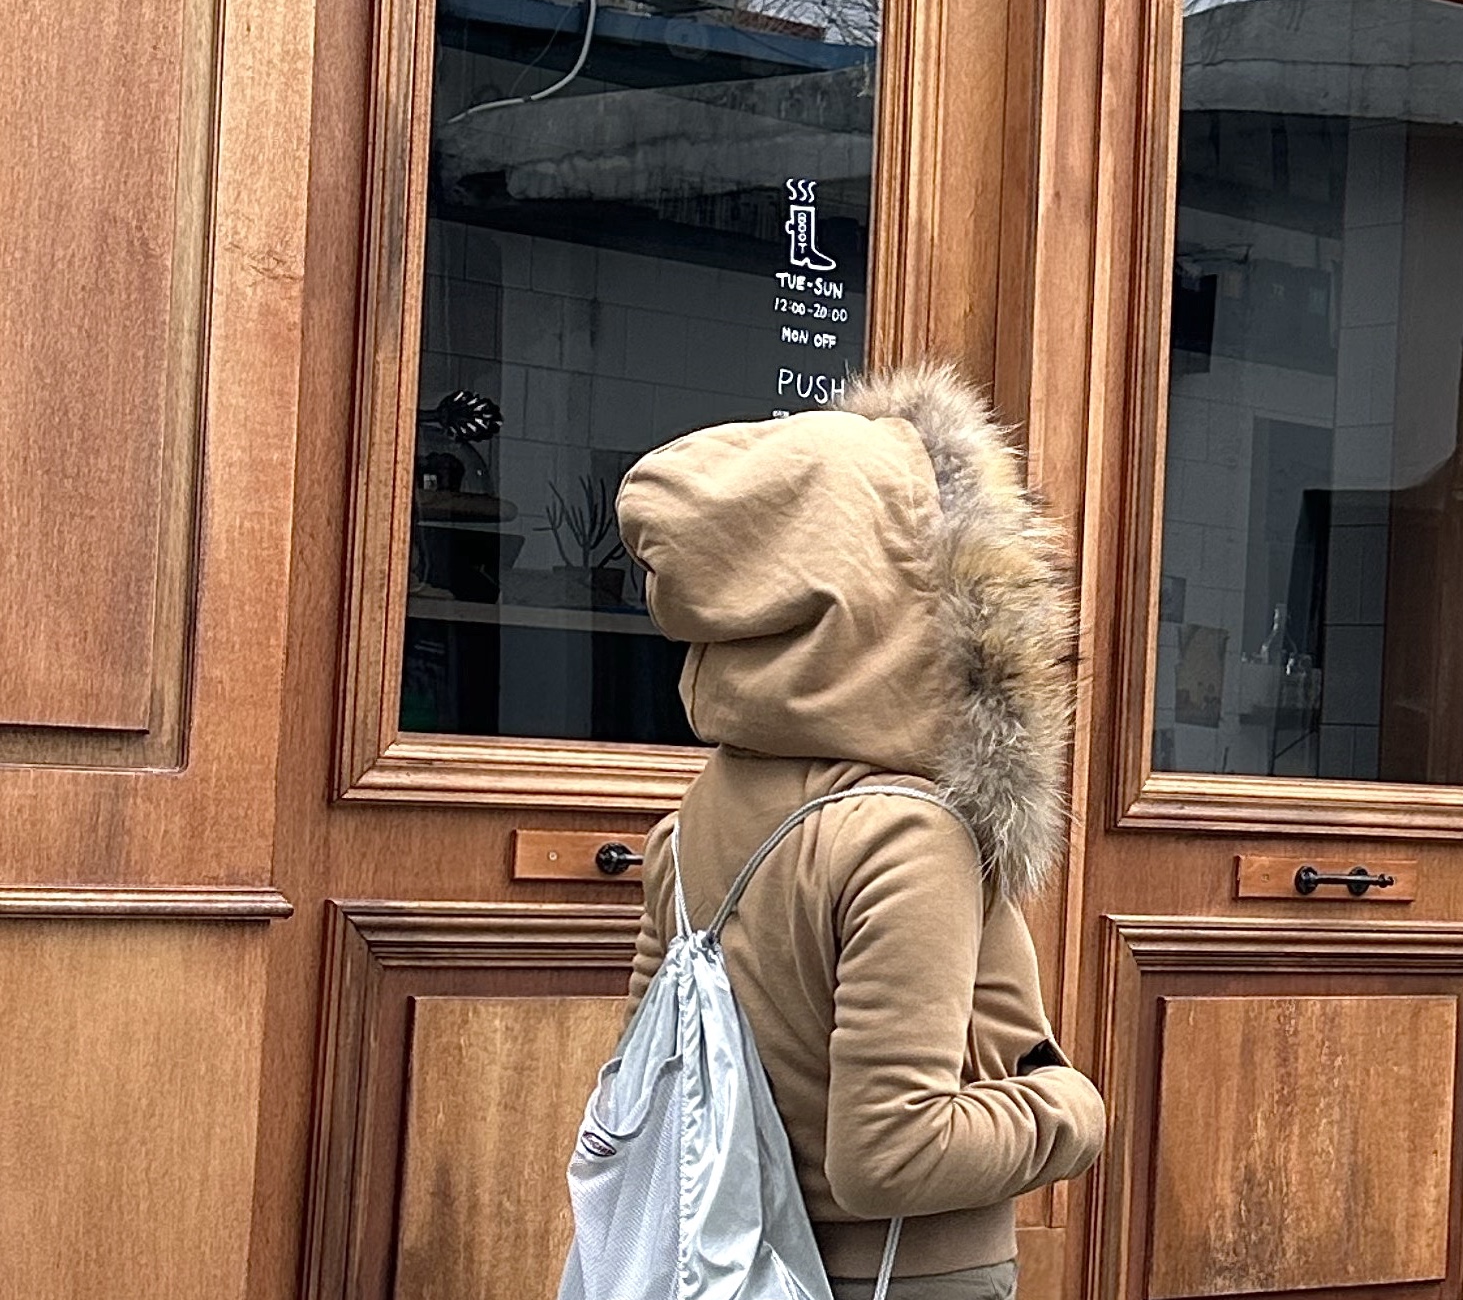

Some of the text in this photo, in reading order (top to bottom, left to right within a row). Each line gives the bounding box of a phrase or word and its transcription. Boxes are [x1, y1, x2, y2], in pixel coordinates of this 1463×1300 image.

[775, 271, 844, 299] TUE-SUN
[781, 326, 837, 349] MON OFF
[777, 368, 845, 404] PUSH
